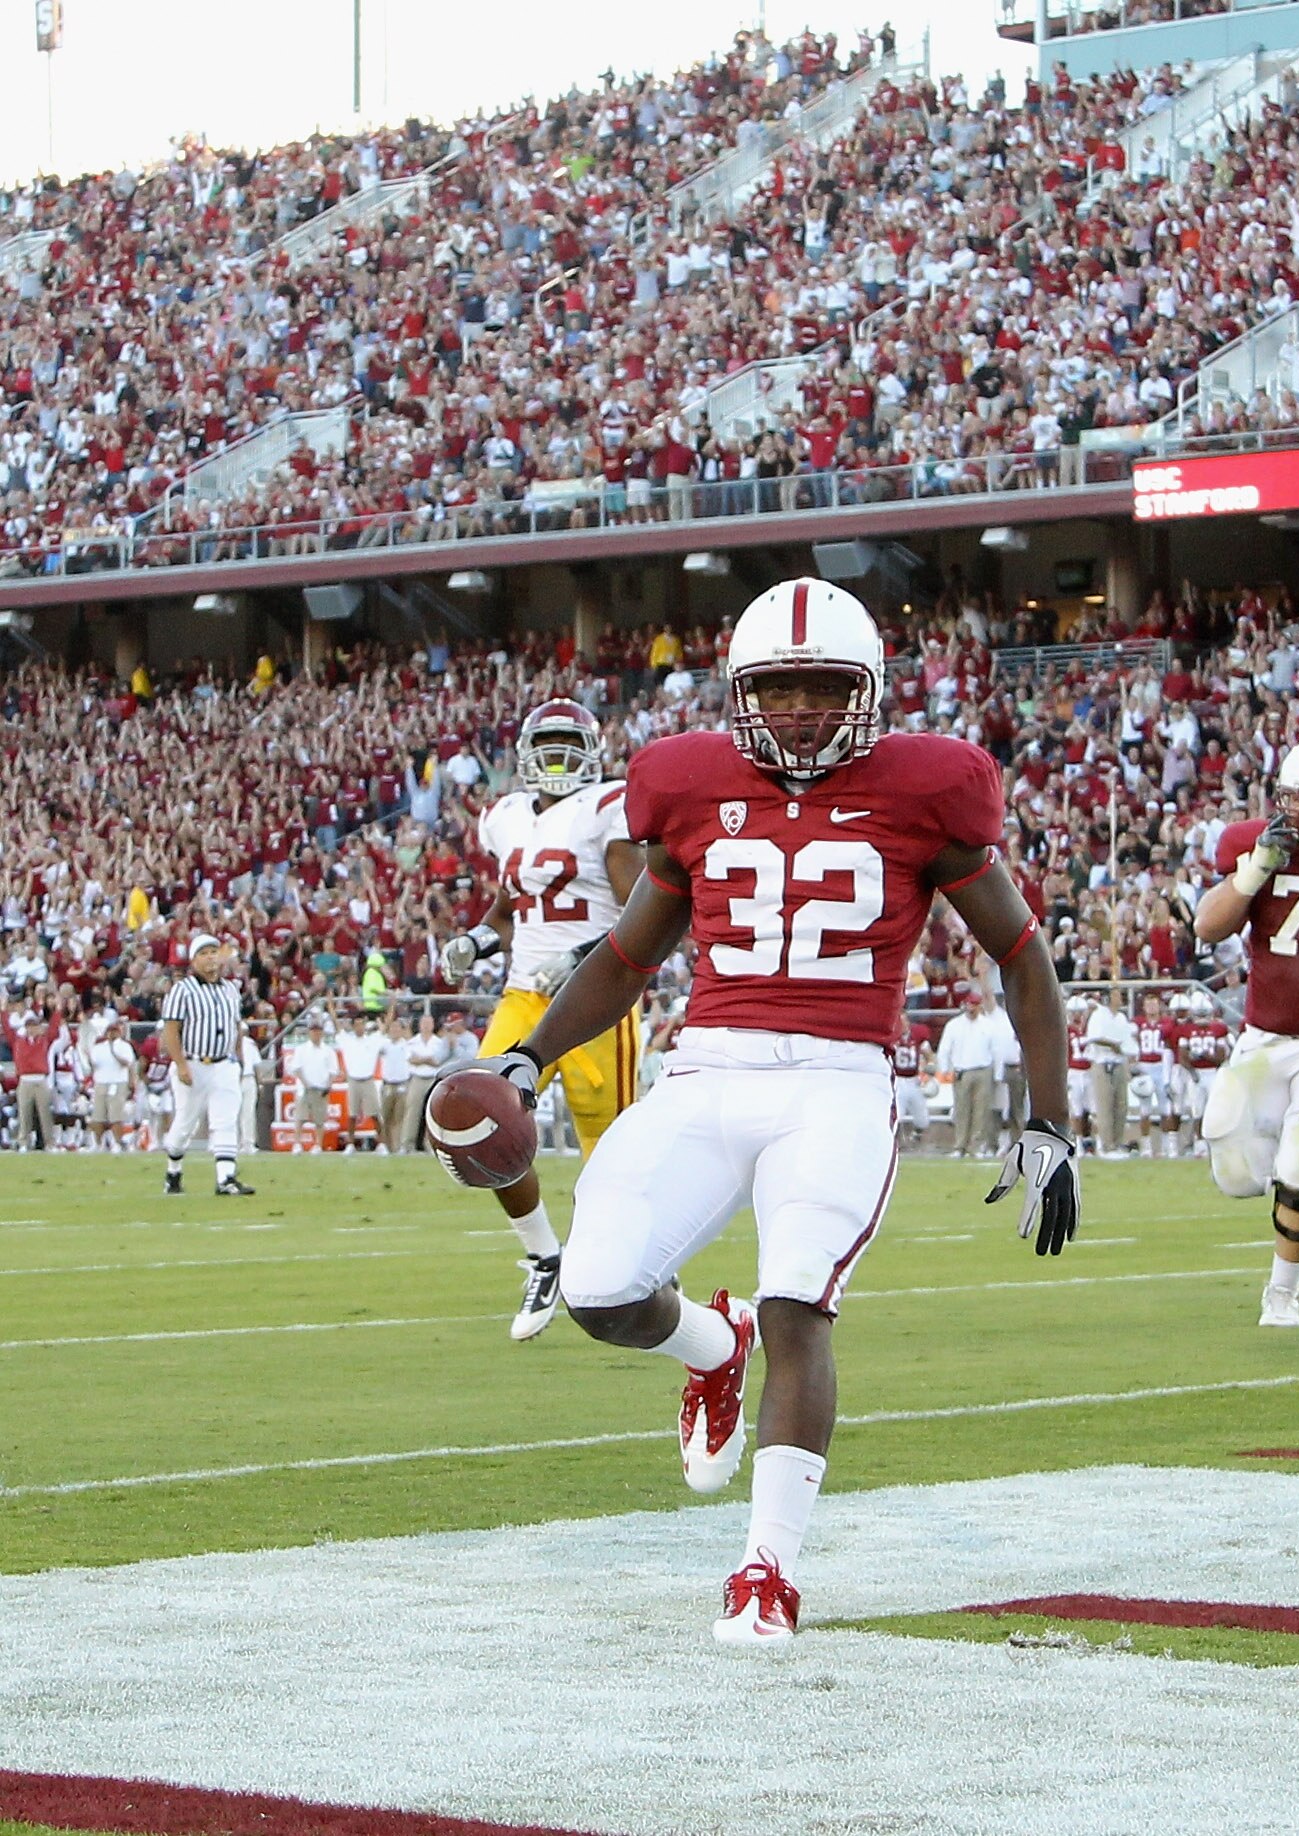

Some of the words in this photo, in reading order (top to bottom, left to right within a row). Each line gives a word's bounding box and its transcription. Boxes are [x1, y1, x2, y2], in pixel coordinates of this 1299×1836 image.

[1134, 467, 1182, 492] USC
[1134, 485, 1259, 518] STANFORD
[787, 801, 800, 819] S
[502, 848, 589, 923] 42
[704, 839, 884, 982] 32
